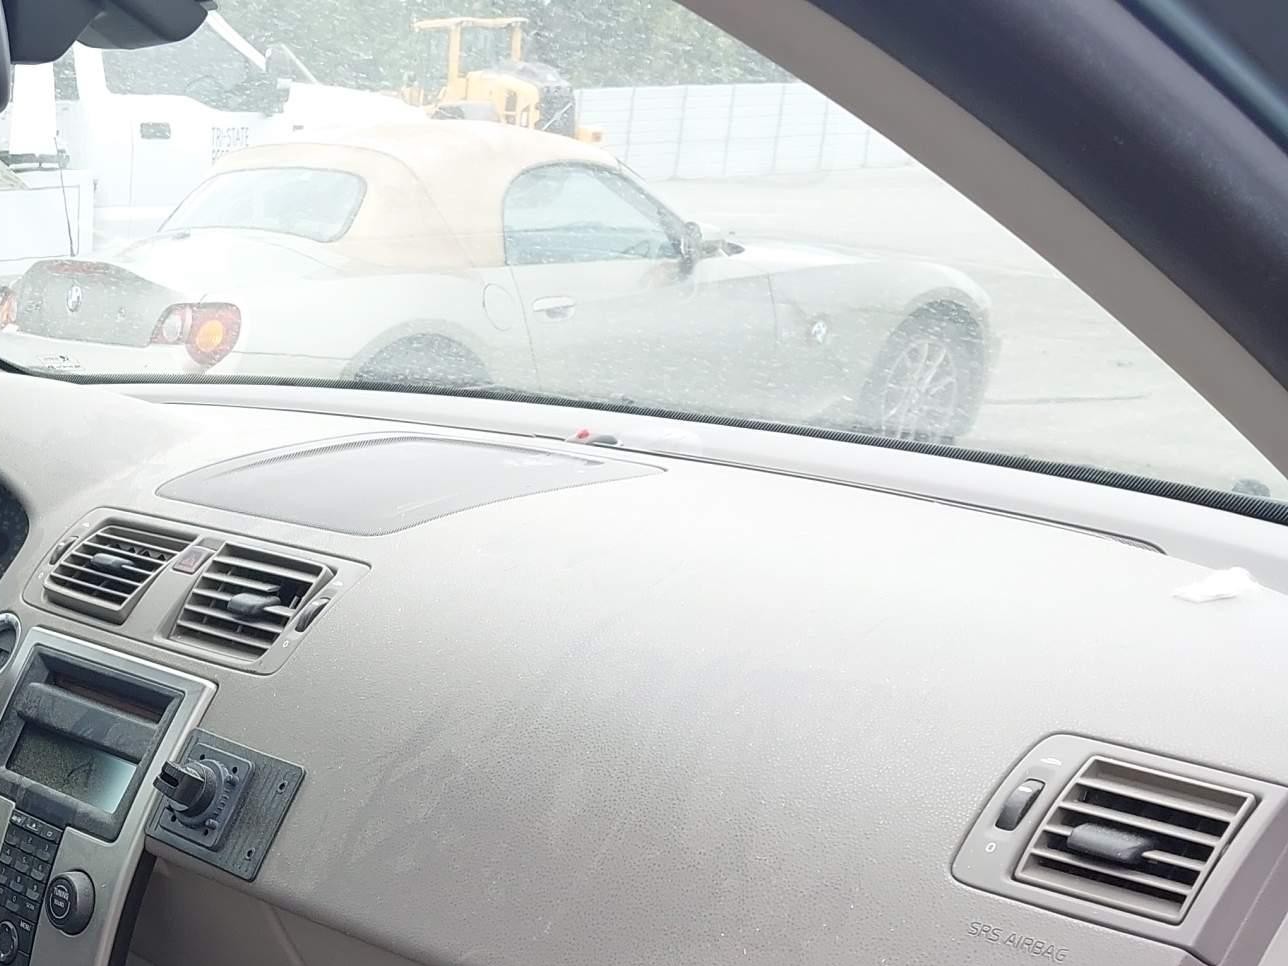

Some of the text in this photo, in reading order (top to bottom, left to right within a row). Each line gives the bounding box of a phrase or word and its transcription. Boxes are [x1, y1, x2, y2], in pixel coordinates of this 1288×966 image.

[207, 123, 236, 139] TRI-STATE
[53, 886, 69, 901] TUNING
[1003, 932, 1070, 962] AIRBAG
